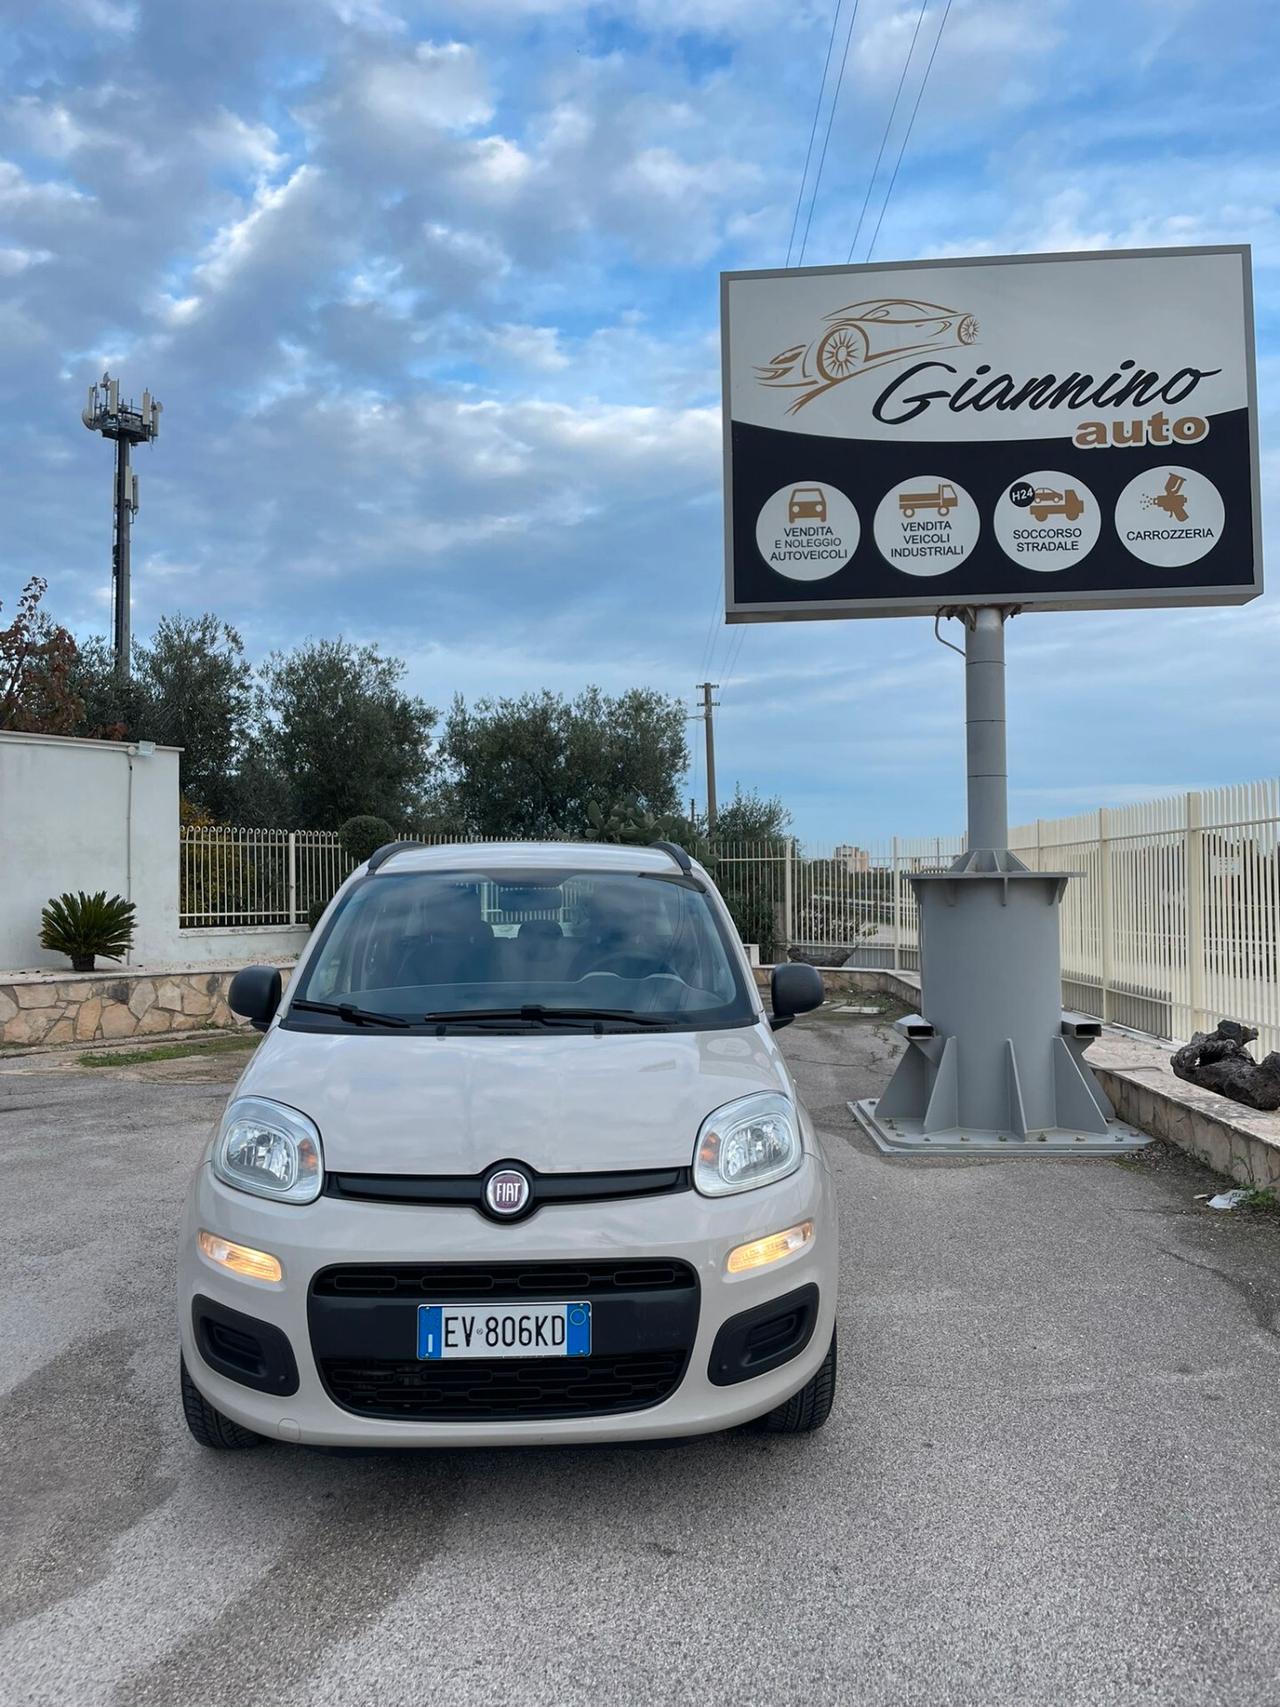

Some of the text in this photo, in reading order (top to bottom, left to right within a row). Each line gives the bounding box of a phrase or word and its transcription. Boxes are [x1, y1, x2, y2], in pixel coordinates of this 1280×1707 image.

[872, 359, 1222, 425] Giannino
[1074, 410, 1207, 446] auto
[1012, 487, 1034, 502] H24
[784, 526, 834, 538] VENDITA
[901, 520, 952, 532] VENDITA
[903, 534, 950, 545] VEICOLI
[1013, 528, 1082, 540] SOCCORSO
[1126, 527, 1215, 541] CARROZZERIA
[775, 537, 842, 549] E NOLEGGIO
[1016, 541, 1079, 552] STRADALE
[770, 549, 848, 562] AUTOVEICOLI
[890, 545, 964, 558] INDUSTRIALI
[496, 1182, 521, 1202] FIAT
